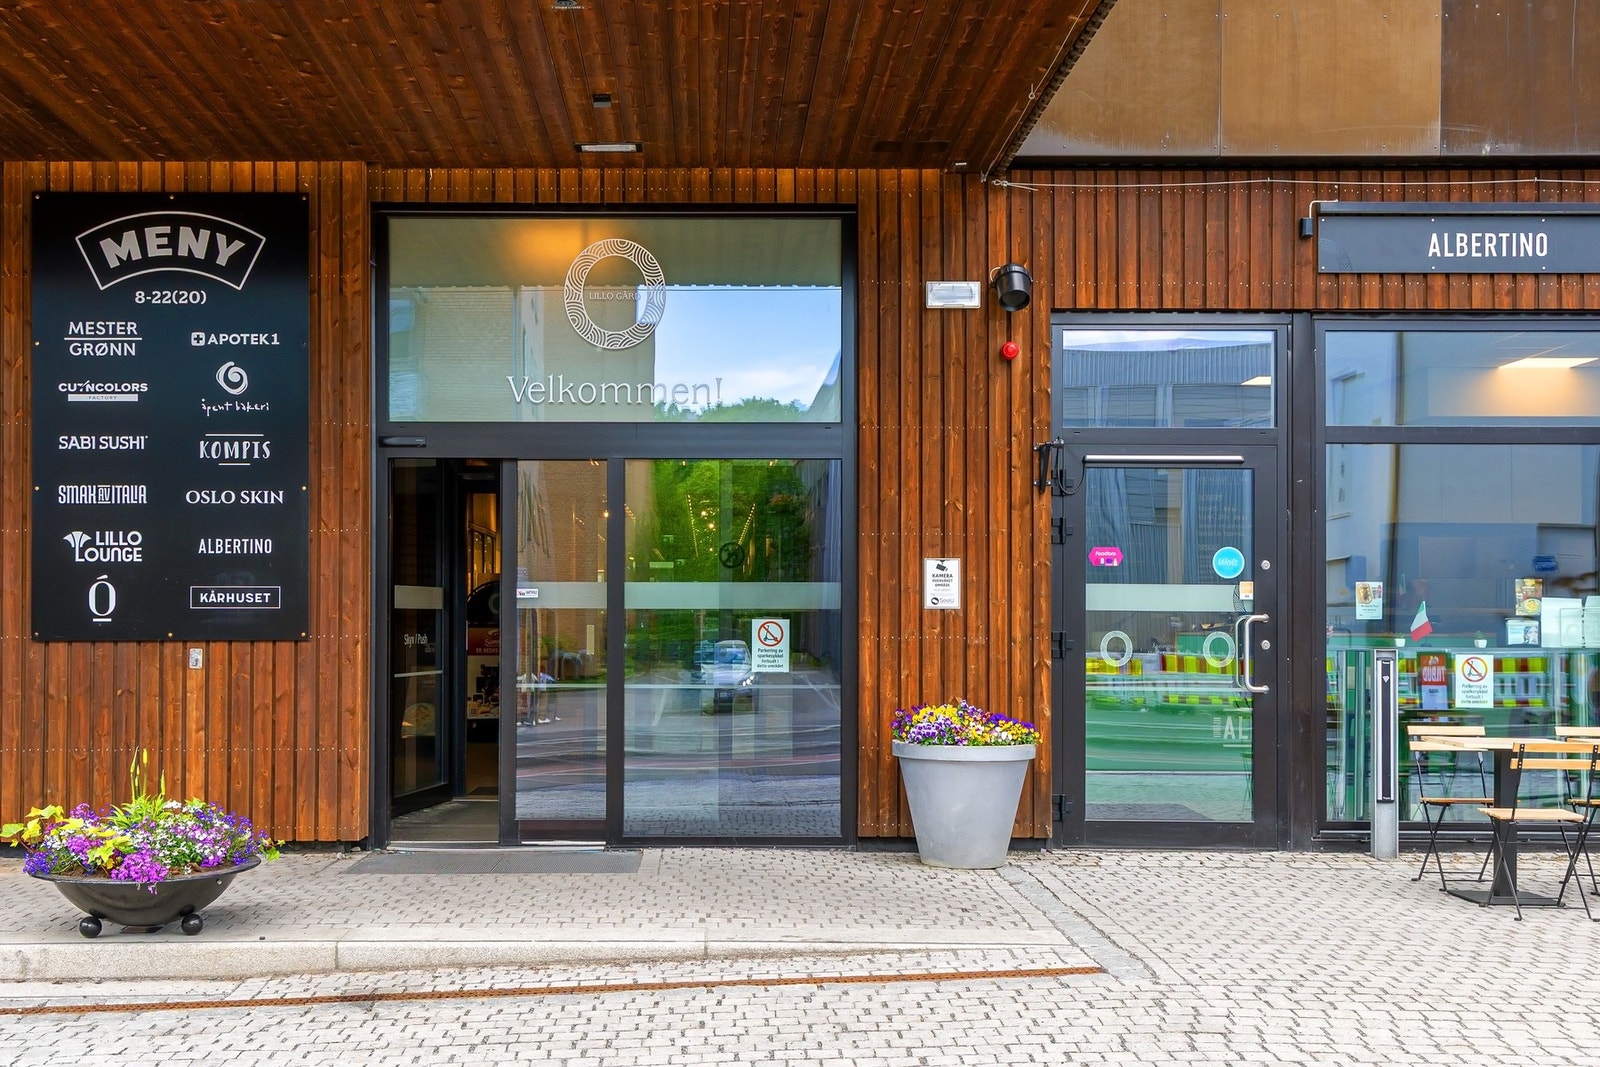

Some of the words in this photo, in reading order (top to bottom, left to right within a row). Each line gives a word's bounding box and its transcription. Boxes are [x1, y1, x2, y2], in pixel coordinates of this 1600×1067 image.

[99, 226, 246, 269] MENY
[1428, 232, 1548, 257] ALBERTINO
[134, 290, 207, 305] 8-22(20)
[589, 292, 614, 300] LILLO
[615, 290, 642, 300] GÅRD
[68, 321, 138, 335] MESTER
[207, 333, 268, 345] APOTEK
[270, 333, 280, 345] 1
[69, 343, 136, 356] GRØNN
[507, 374, 722, 405] Velkommen!
[58, 435, 96, 450] SABI
[98, 435, 145, 450] SUSHI
[199, 440, 271, 459] KOMPIS
[58, 484, 97, 504] SMAK
[98, 487, 111, 501] AV
[111, 484, 148, 504] ITALIA
[185, 490, 236, 504] OSLO
[239, 490, 285, 504] SKIN
[95, 531, 143, 546] LILLO
[198, 538, 273, 554] ALBERTINO
[75, 547, 143, 562] LOUNGE
[200, 589, 272, 603] KÅRHUSET
